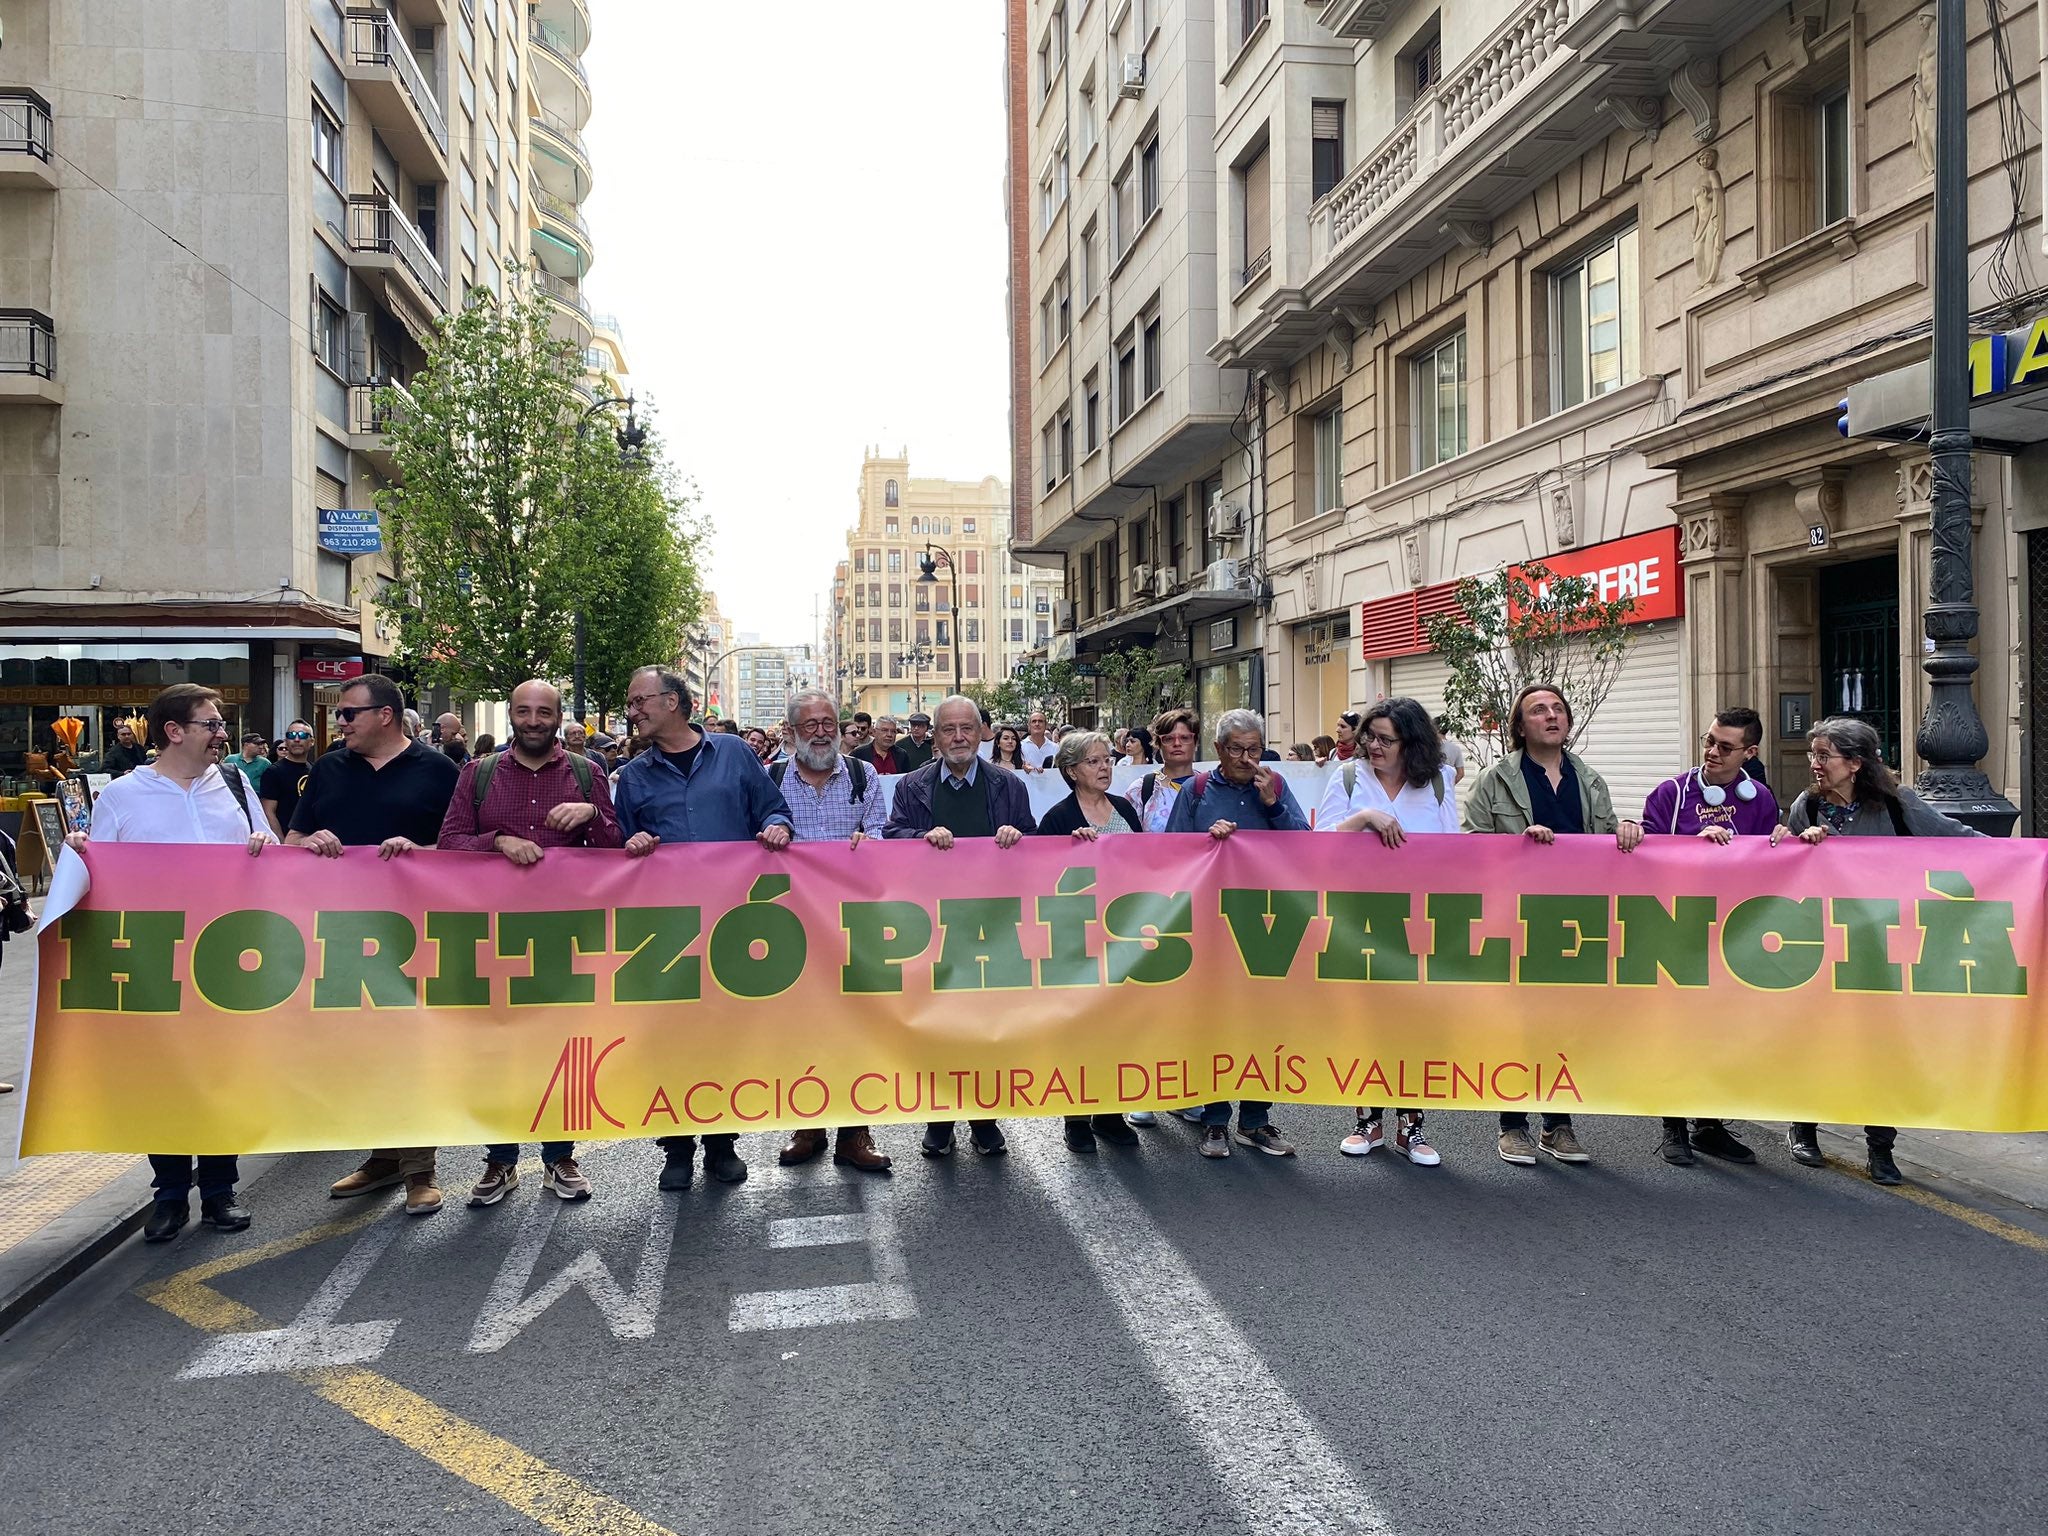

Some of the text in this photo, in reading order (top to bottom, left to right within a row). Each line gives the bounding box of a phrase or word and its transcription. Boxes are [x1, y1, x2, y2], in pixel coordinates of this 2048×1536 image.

[323, 538, 377, 546] 963 210 289
[1810, 527, 1824, 545] 82
[316, 661, 347, 673] CHIC
[57, 866, 2028, 1015] HORITZÓ PAÍS VALENCIÀ
[641, 1044, 1583, 1127] ACCIÓ CULTURAL DEL PAÍS VALENCIÀ
